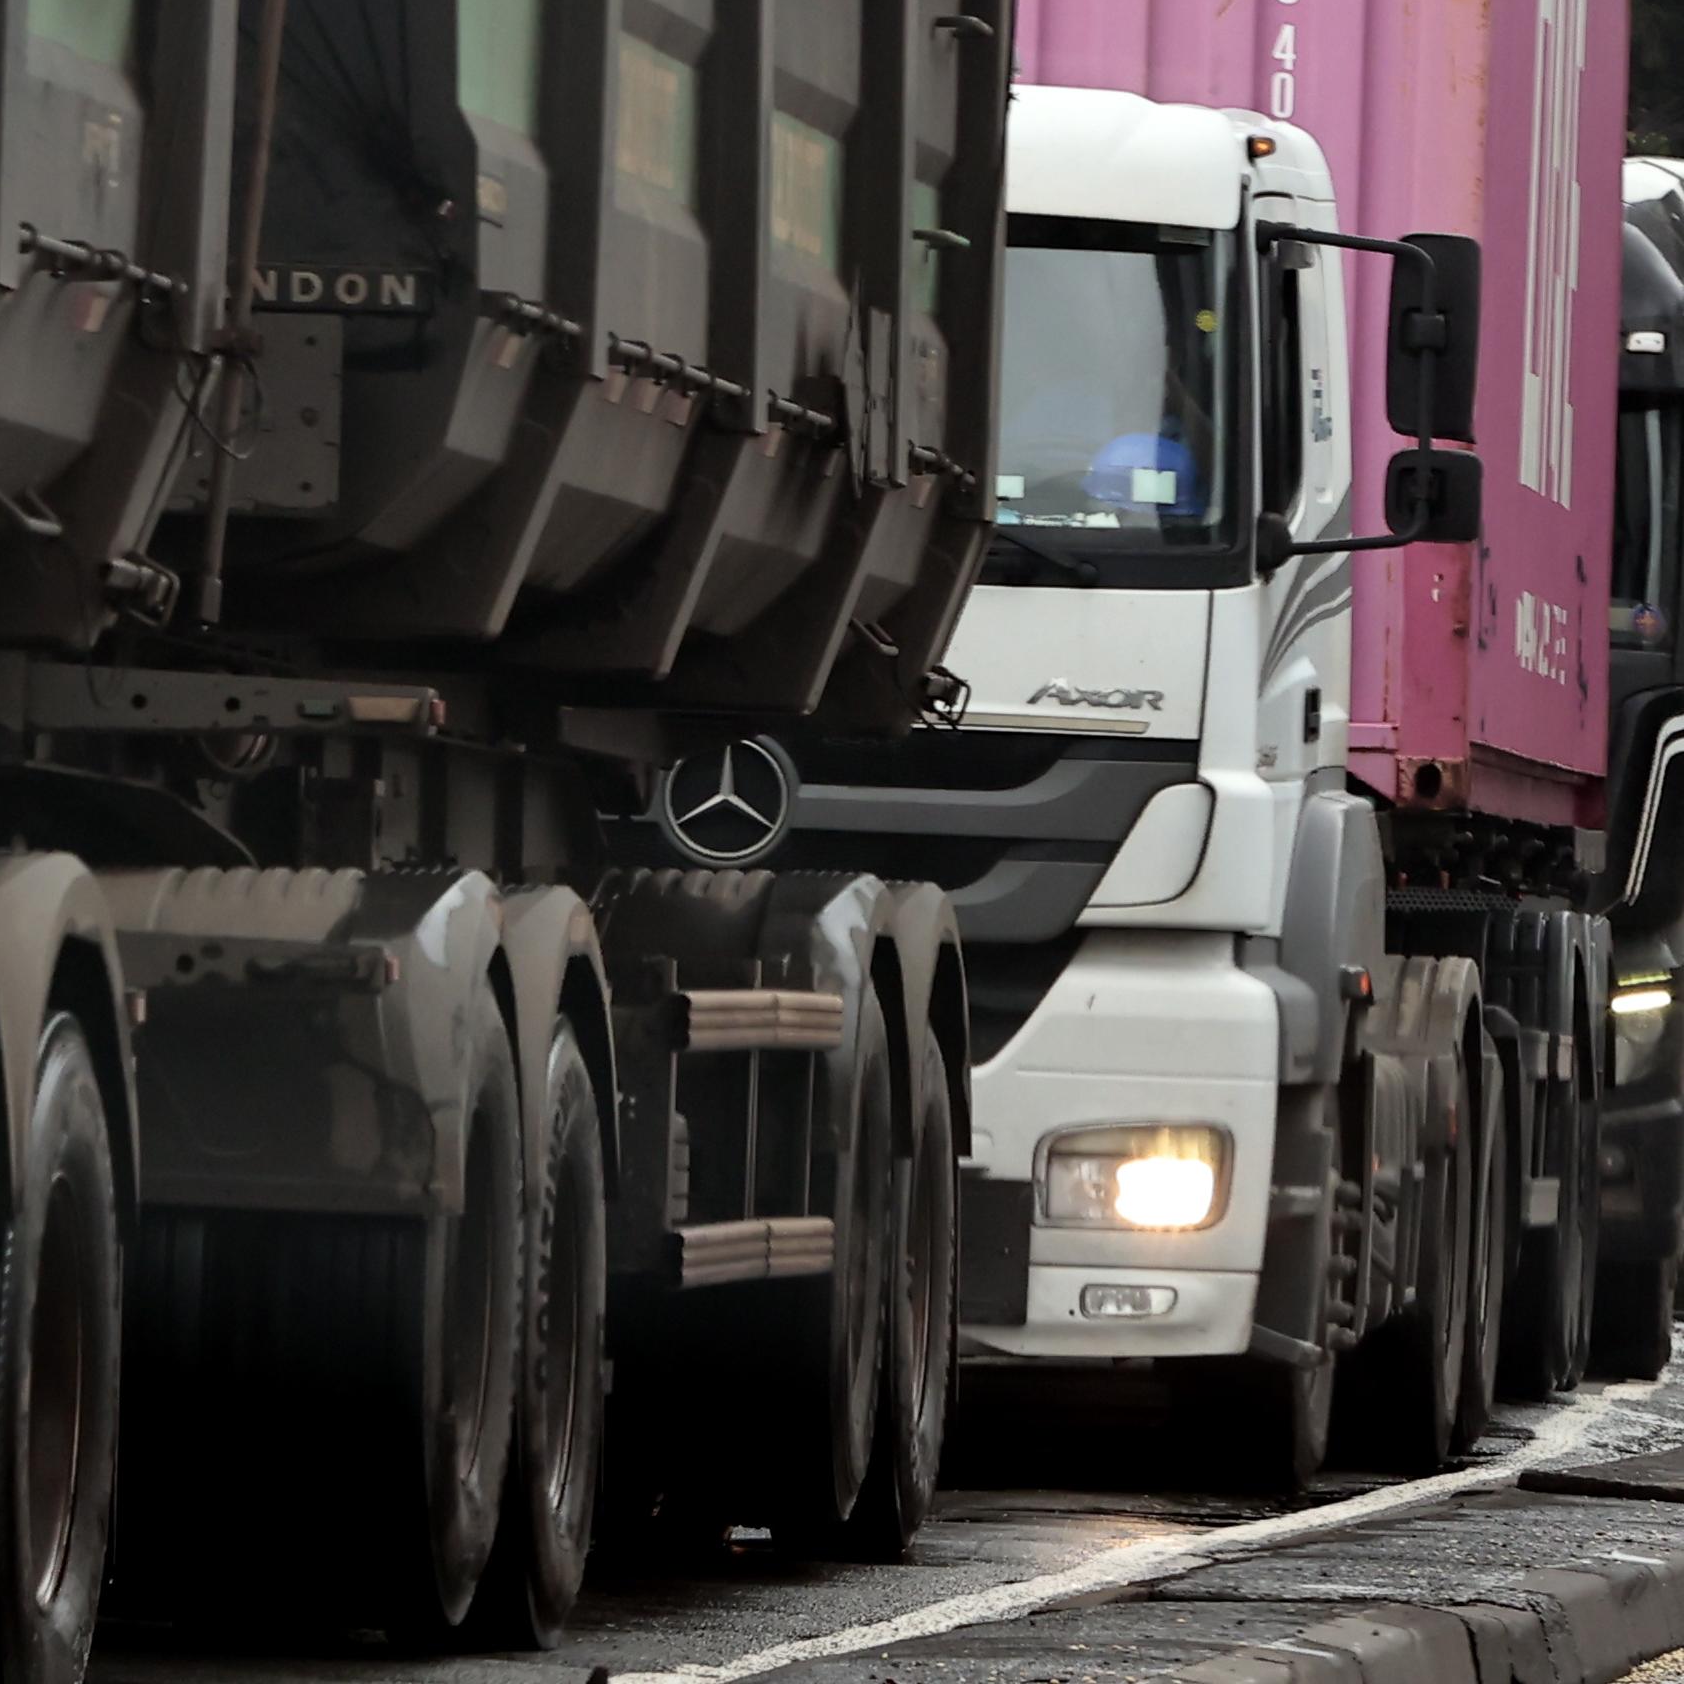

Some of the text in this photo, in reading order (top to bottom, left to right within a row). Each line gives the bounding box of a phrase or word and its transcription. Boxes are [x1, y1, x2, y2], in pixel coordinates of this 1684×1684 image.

[1270, 23, 1297, 119] 40
[248, 268, 416, 306] NDON
[1027, 677, 1165, 711] AXOR
